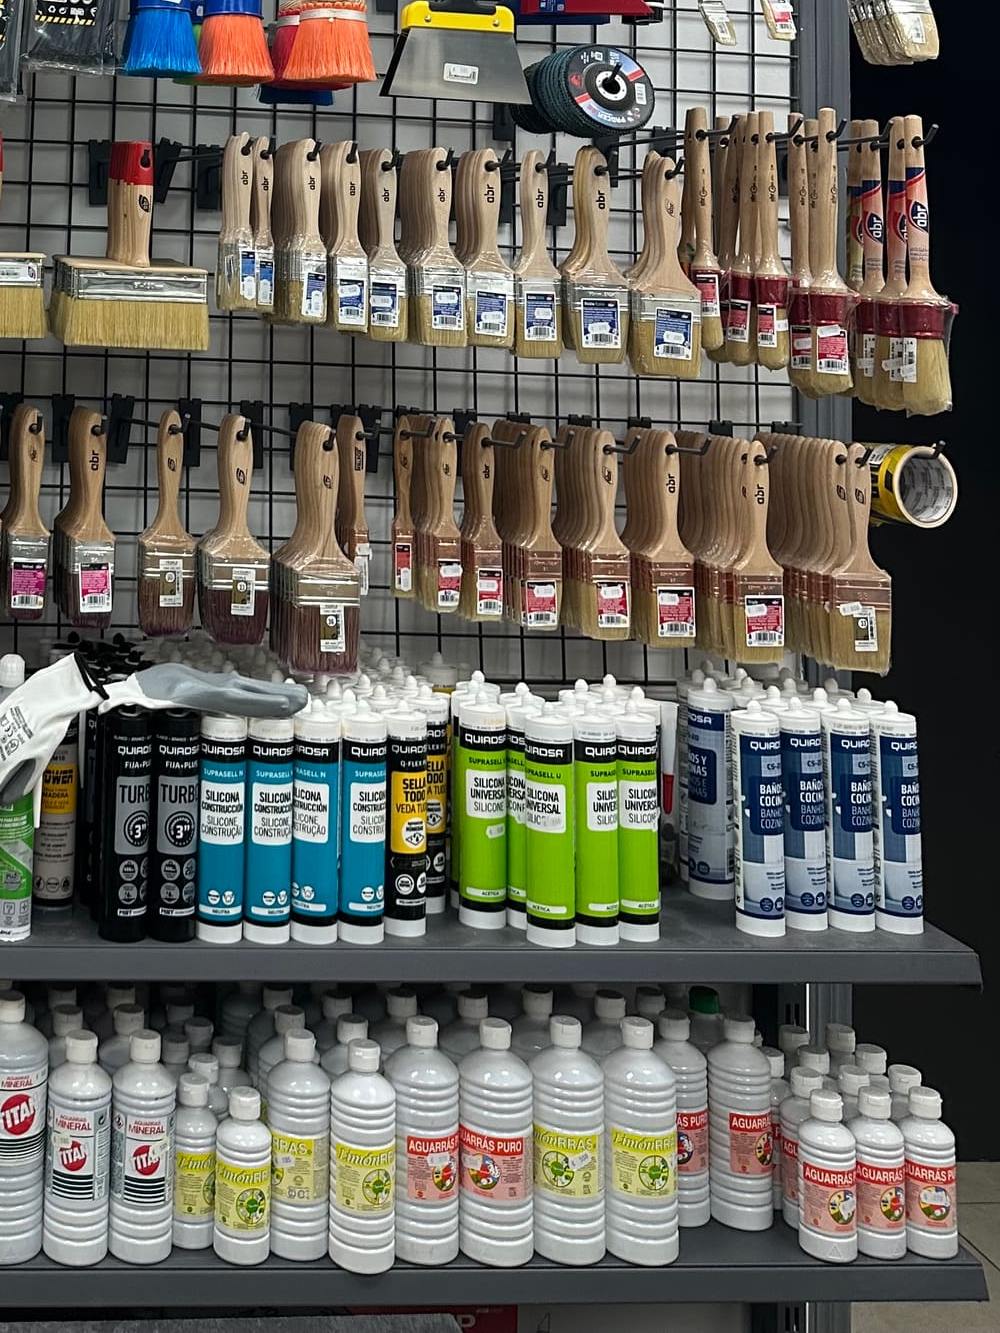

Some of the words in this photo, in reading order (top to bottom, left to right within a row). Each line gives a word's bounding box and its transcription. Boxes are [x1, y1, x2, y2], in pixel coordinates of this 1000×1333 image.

[438, 187, 446, 203] abr
[487, 183, 495, 204] abr
[536, 187, 544, 209] abr
[597, 190, 606, 211] abr
[913, 205, 927, 226] abr
[89, 450, 99, 472] abr
[667, 473, 676, 494] abr
[756, 483, 765, 505] abr
[201, 744, 245, 755] QUIADSA
[469, 757, 501, 765] SUPRASELL
[204, 769, 236, 778] SUPRASELL
[205, 790, 240, 802] SILICONA
[404, 790, 425, 802] TODO
[527, 789, 560, 802] SILICONA
[201, 801, 244, 814] CONSTRUCCIÓN
[396, 803, 416, 814] VEDA
[474, 801, 504, 812] SILICONE
[207, 815, 238, 827] SILICONE
[261, 816, 289, 828] SILICONE
[201, 823, 243, 837] CONSTRUÇÃO
[1, 1079, 33, 1088] MINERAL
[55, 1120, 92, 1131] MINERAL
[128, 1124, 165, 1135] MINERAL
[409, 1137, 454, 1153] AGUARRÁS
[497, 1139, 522, 1152] PURO
[805, 1168, 852, 1185] AGUARRÁS
[857, 1166, 903, 1182] AGUARRÁS
